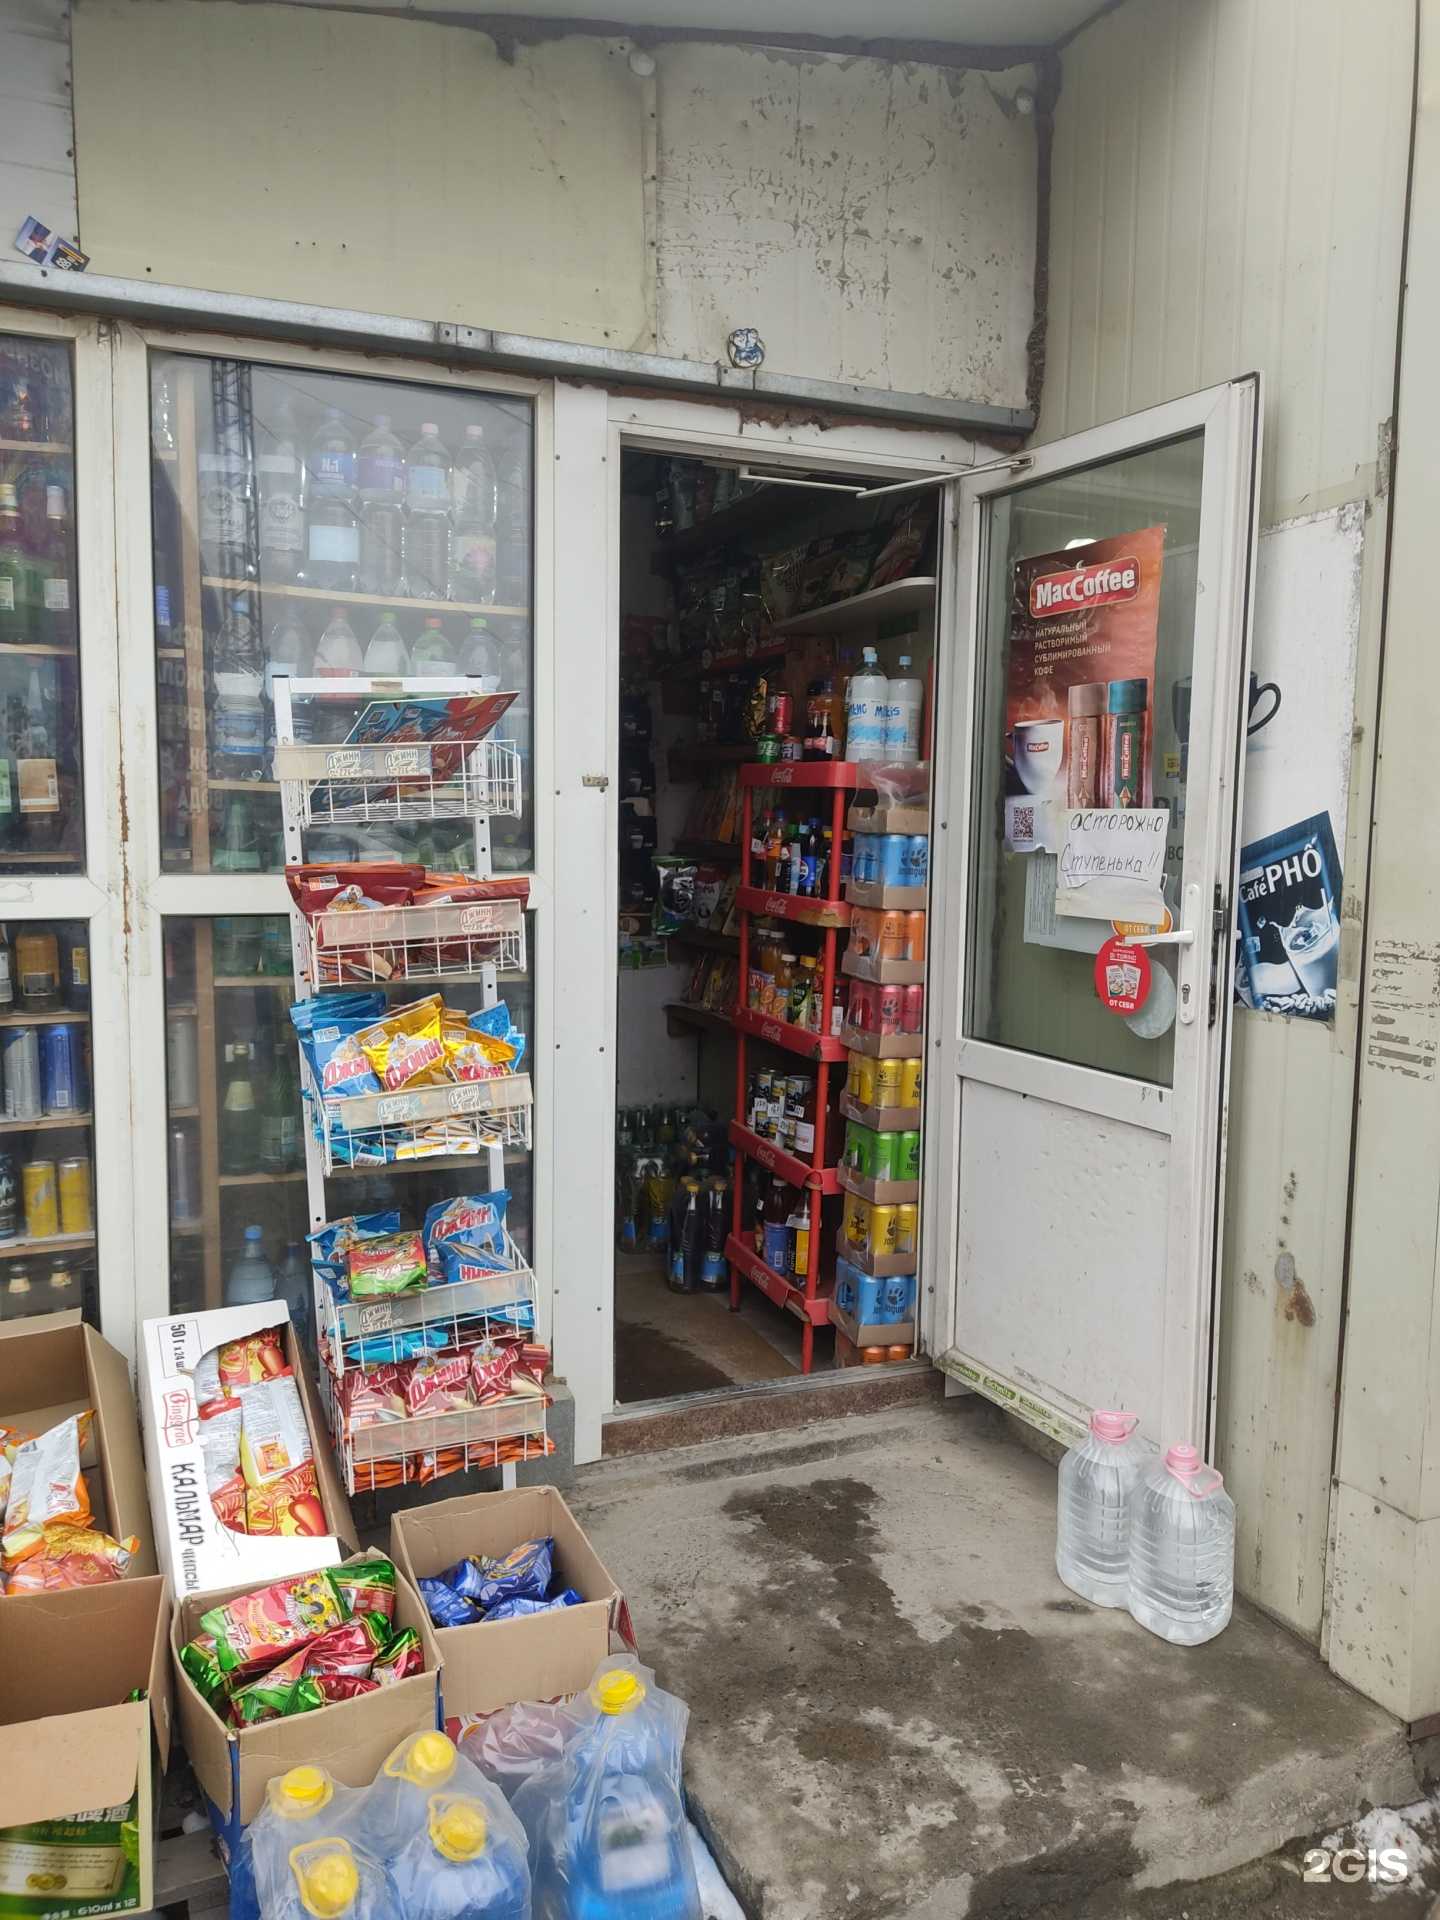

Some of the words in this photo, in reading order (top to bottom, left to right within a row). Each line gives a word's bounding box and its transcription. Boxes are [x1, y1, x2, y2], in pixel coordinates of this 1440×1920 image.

[1036, 569, 1136, 609] MacCoffee
[1034, 619, 1088, 638] НАТУРАЛЬНЫЙ
[1034, 633, 1088, 650] РАСТВОРИМЫЙ
[1034, 641, 1112, 663] СУБЛИМИРОВАННЫЙ
[1034, 665, 1054, 676] КОФЕ
[1060, 843, 1143, 874] Ступенька
[1240, 876, 1268, 904] Café
[1118, 1000, 1135, 1009] СЕБЯ
[171, 1324, 186, 1337] 50
[174, 1351, 185, 1360] 24
[410, 1355, 471, 1413] Джинн
[170, 1393, 187, 1445] Binggrae
[171, 1462, 205, 1546] КАЛЬМАР
[181, 1548, 200, 1590] чипсы
[125, 1898, 136, 1907] 12
